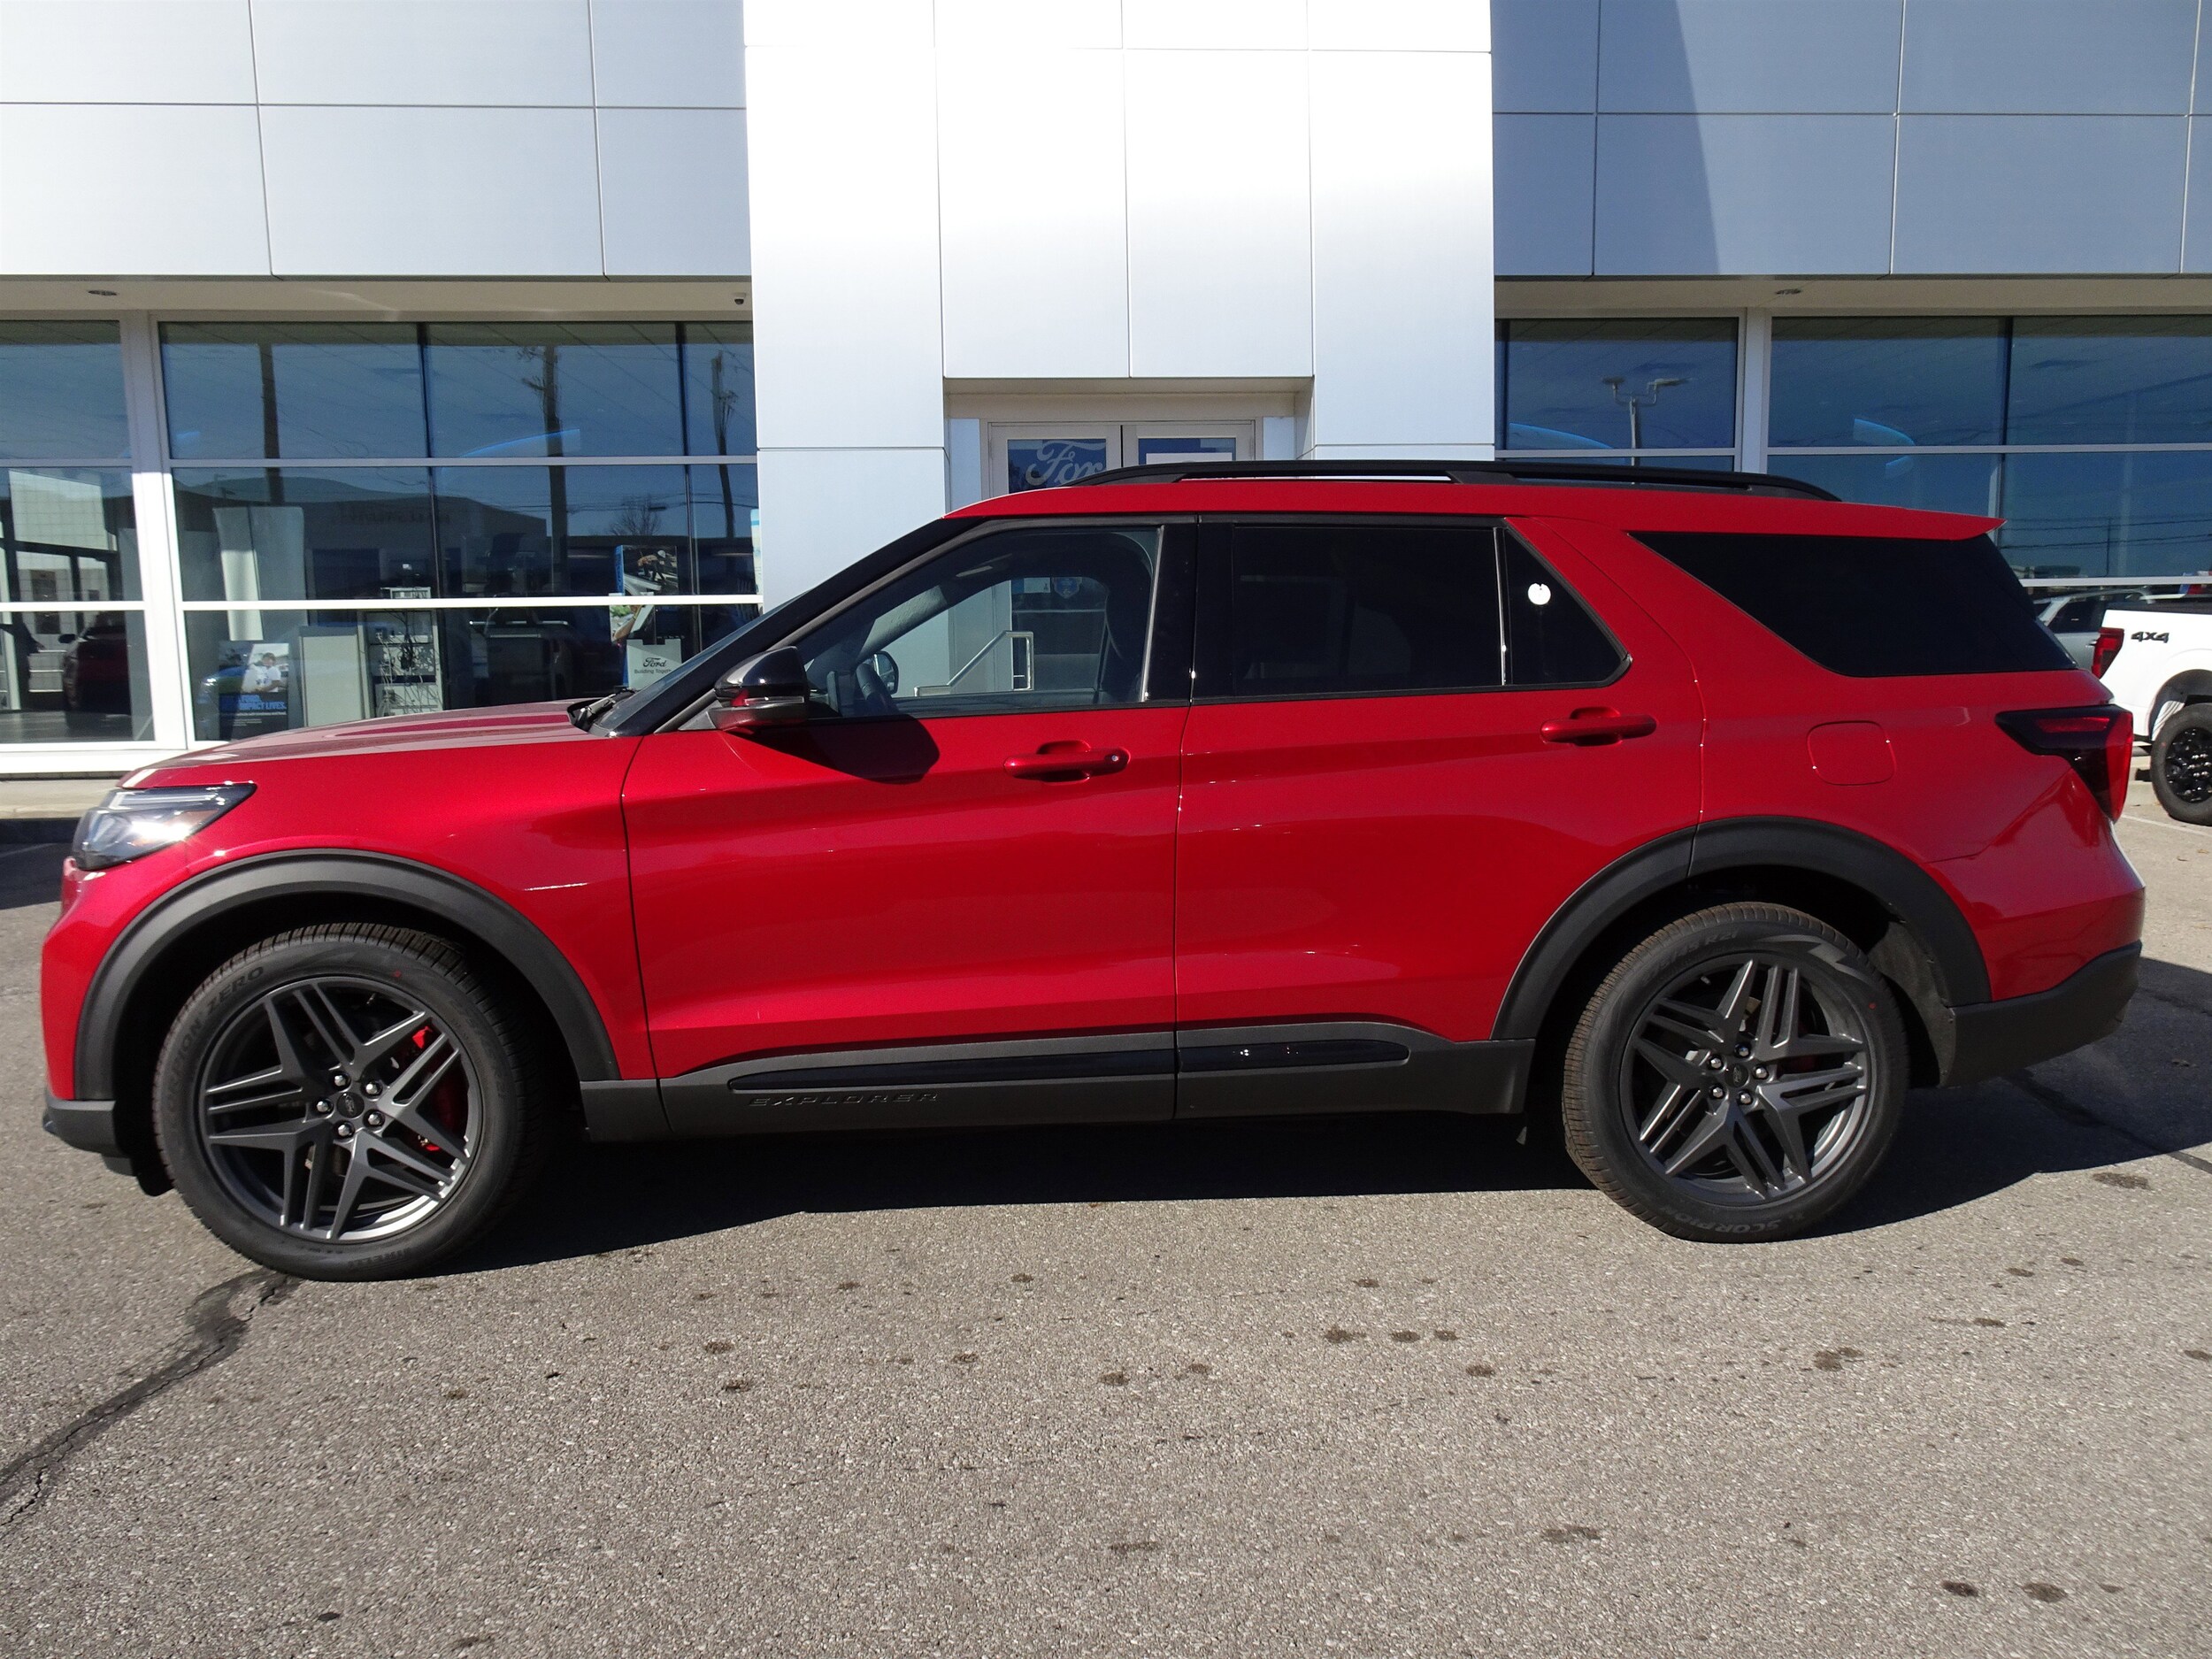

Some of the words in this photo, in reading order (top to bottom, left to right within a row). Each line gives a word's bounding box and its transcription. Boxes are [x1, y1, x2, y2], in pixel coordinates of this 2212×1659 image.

[1026, 441, 1107, 486] For
[643, 657, 666, 667] Ford
[206, 965, 265, 1014] ZERO
[749, 1093, 939, 1106] EXPLORER
